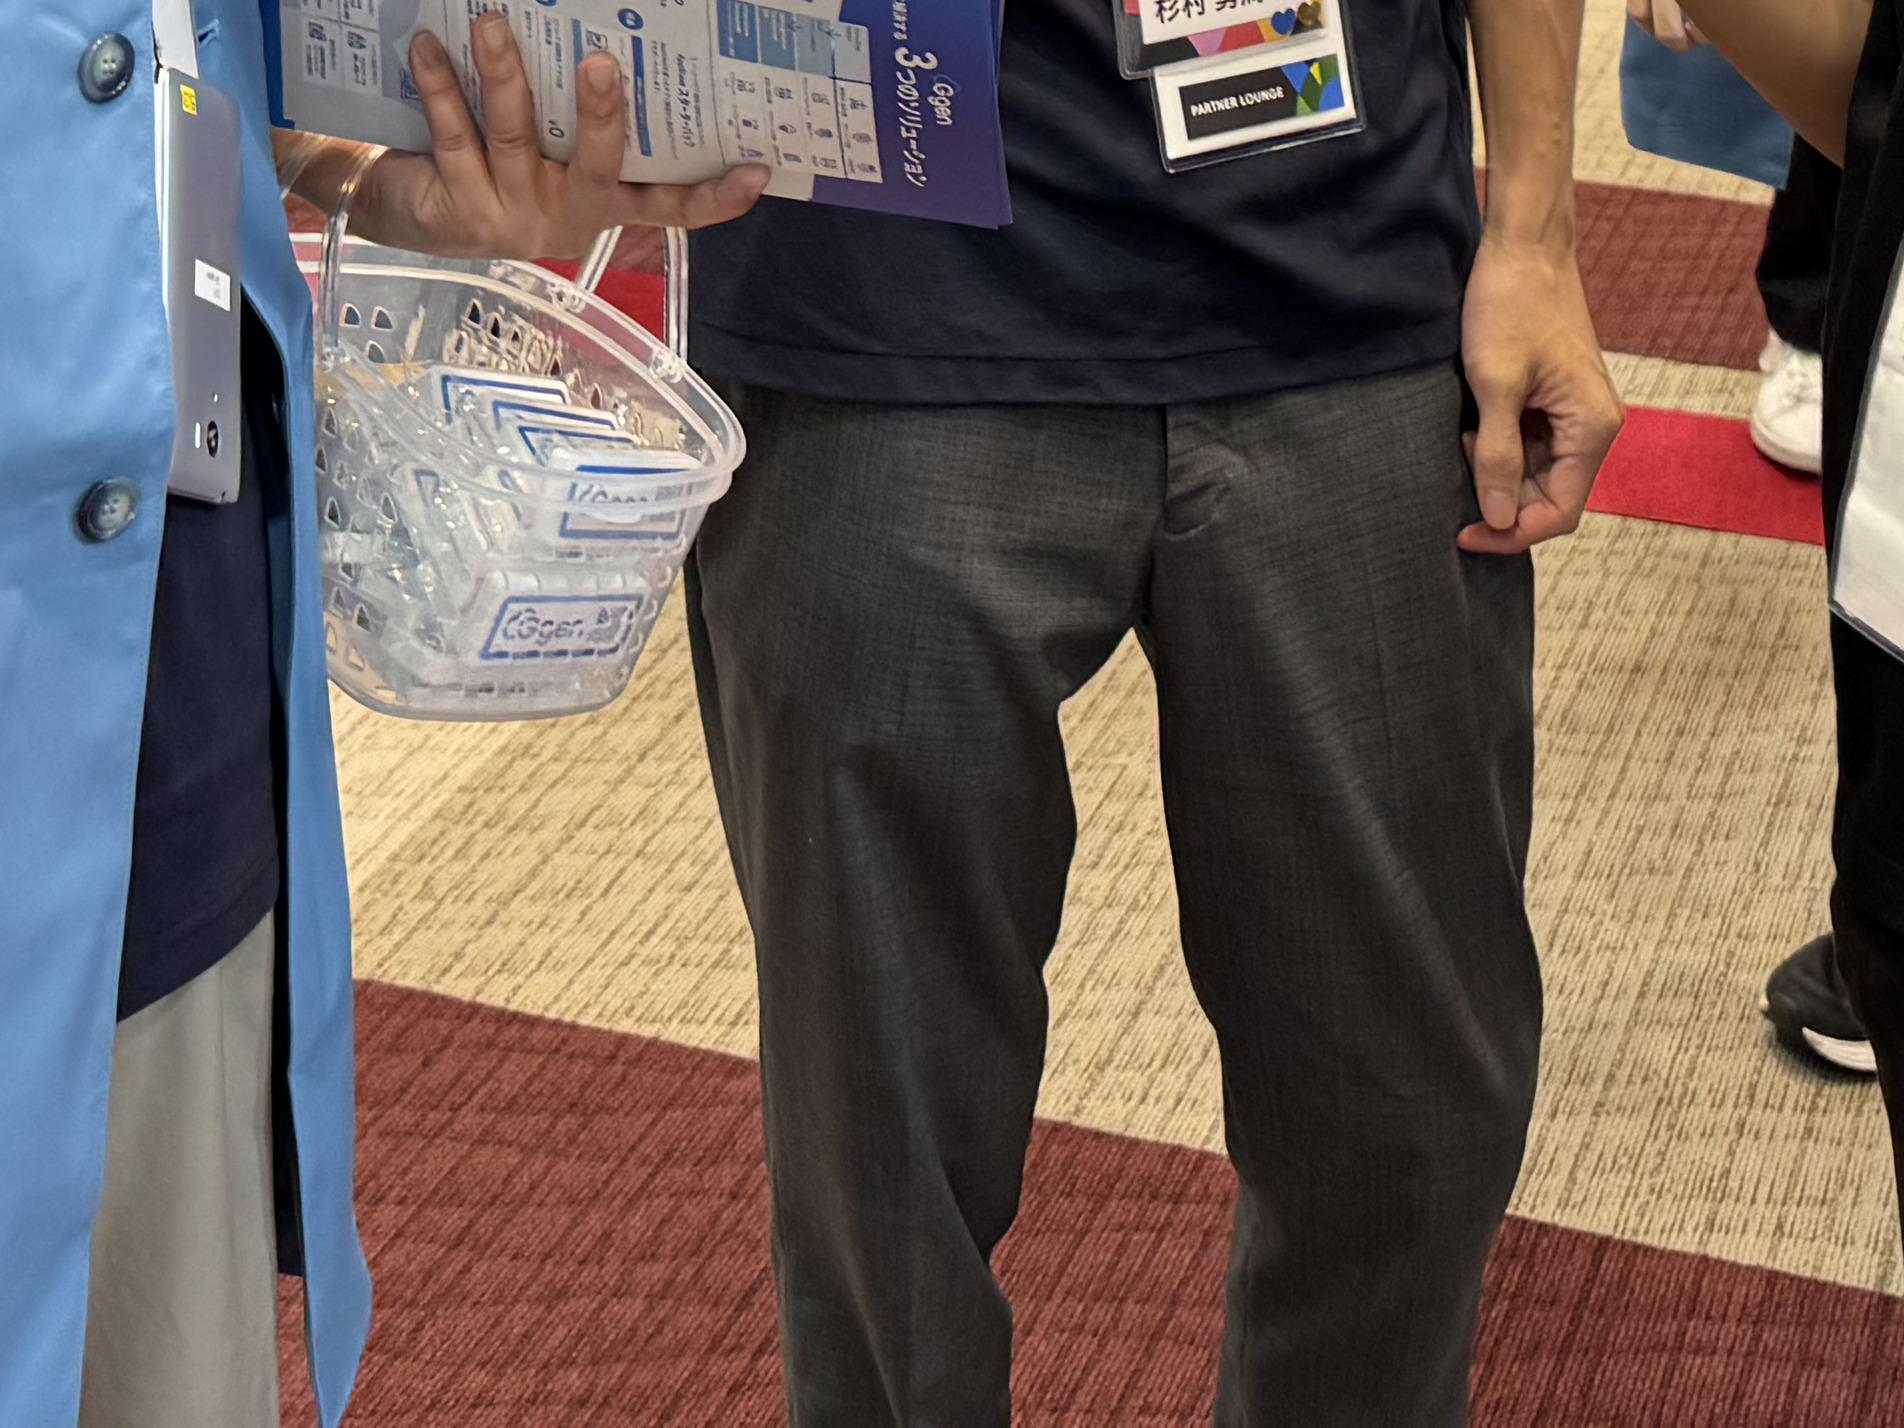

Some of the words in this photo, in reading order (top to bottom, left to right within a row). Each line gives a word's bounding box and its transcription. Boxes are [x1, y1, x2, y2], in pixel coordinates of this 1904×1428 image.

[677, 87, 694, 147] スターターパック
[894, 49, 937, 186] 3つのソリューション
[928, 82, 954, 124] Ggen
[1190, 92, 1238, 118] PARTNER
[1239, 84, 1285, 108] LOUNGE
